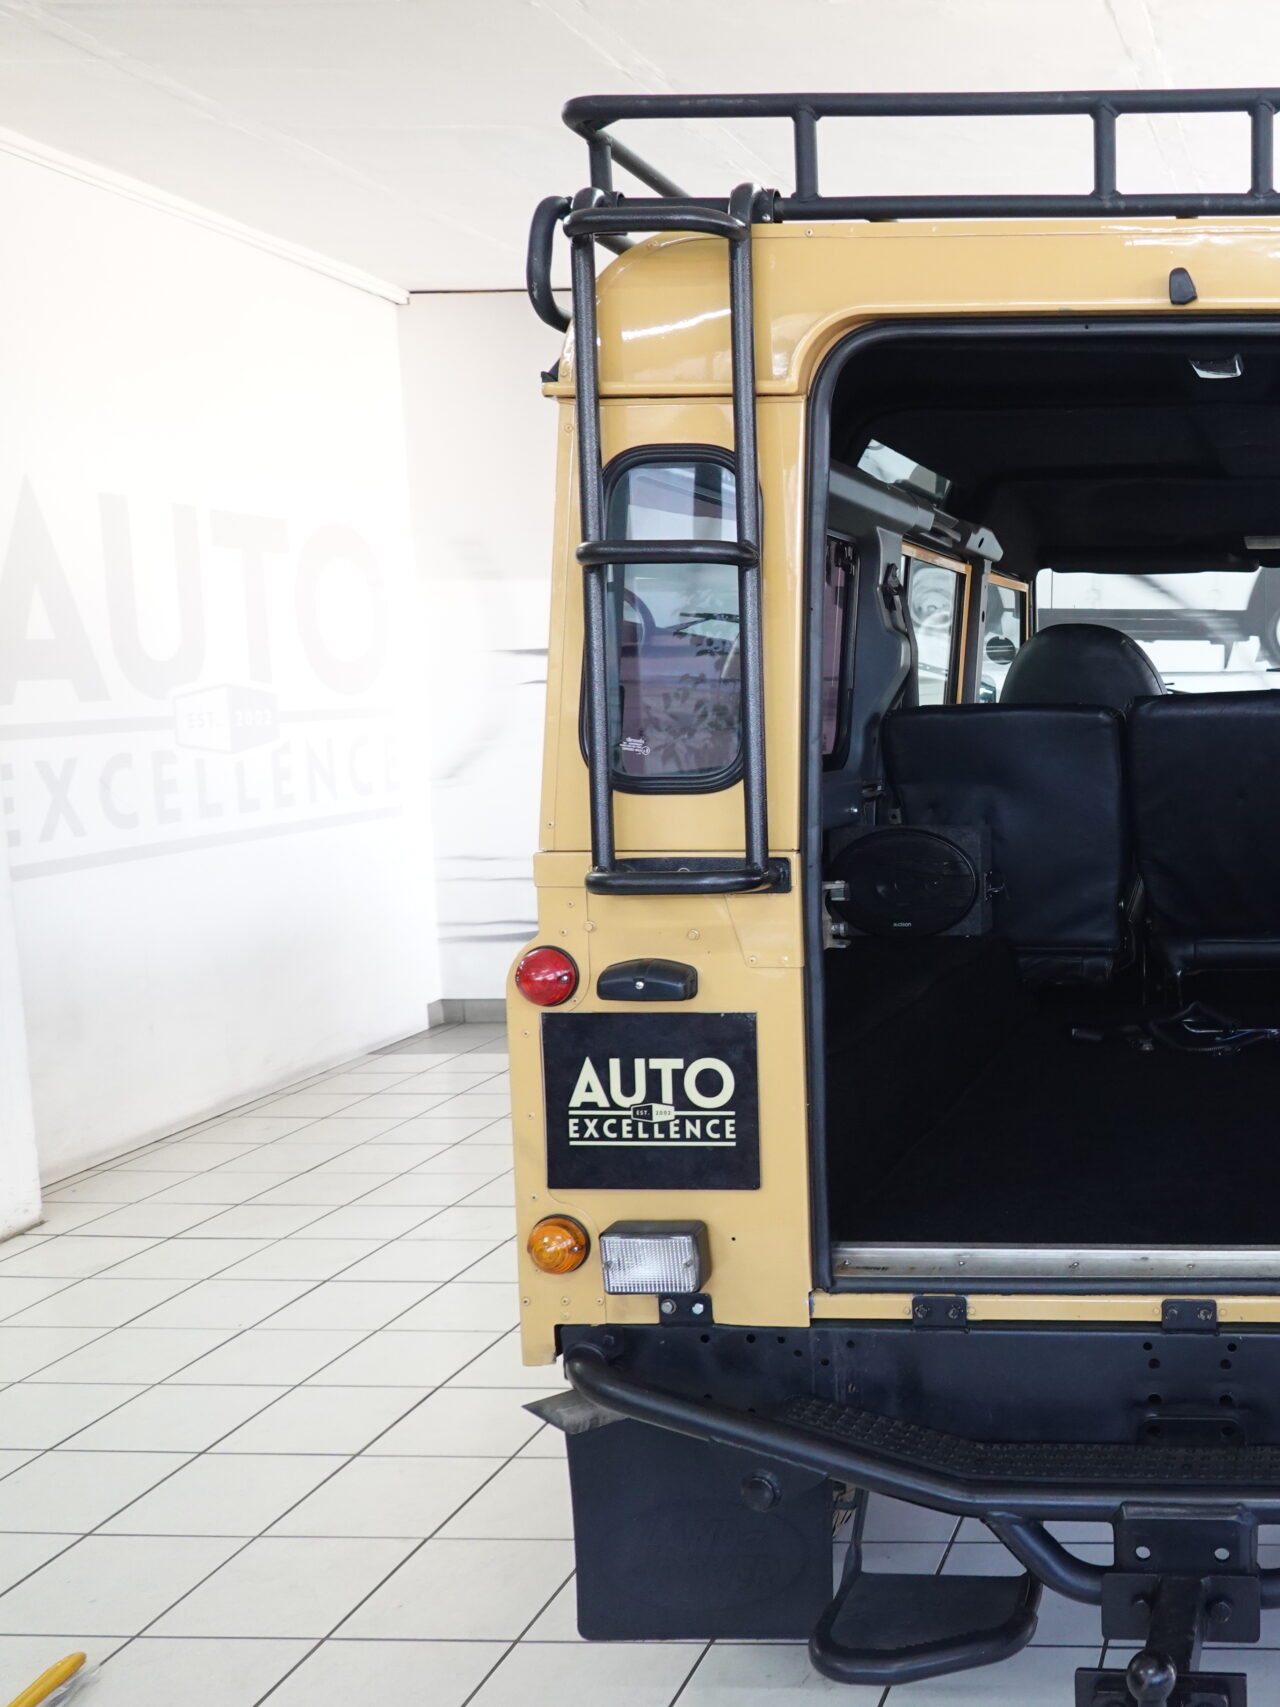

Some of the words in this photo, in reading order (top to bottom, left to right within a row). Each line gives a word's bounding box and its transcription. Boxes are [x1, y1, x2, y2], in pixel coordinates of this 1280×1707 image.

[0, 472, 390, 707] AUTO
[568, 1056, 736, 1109] AUTO
[568, 1118, 737, 1139] EXCELLENCE
